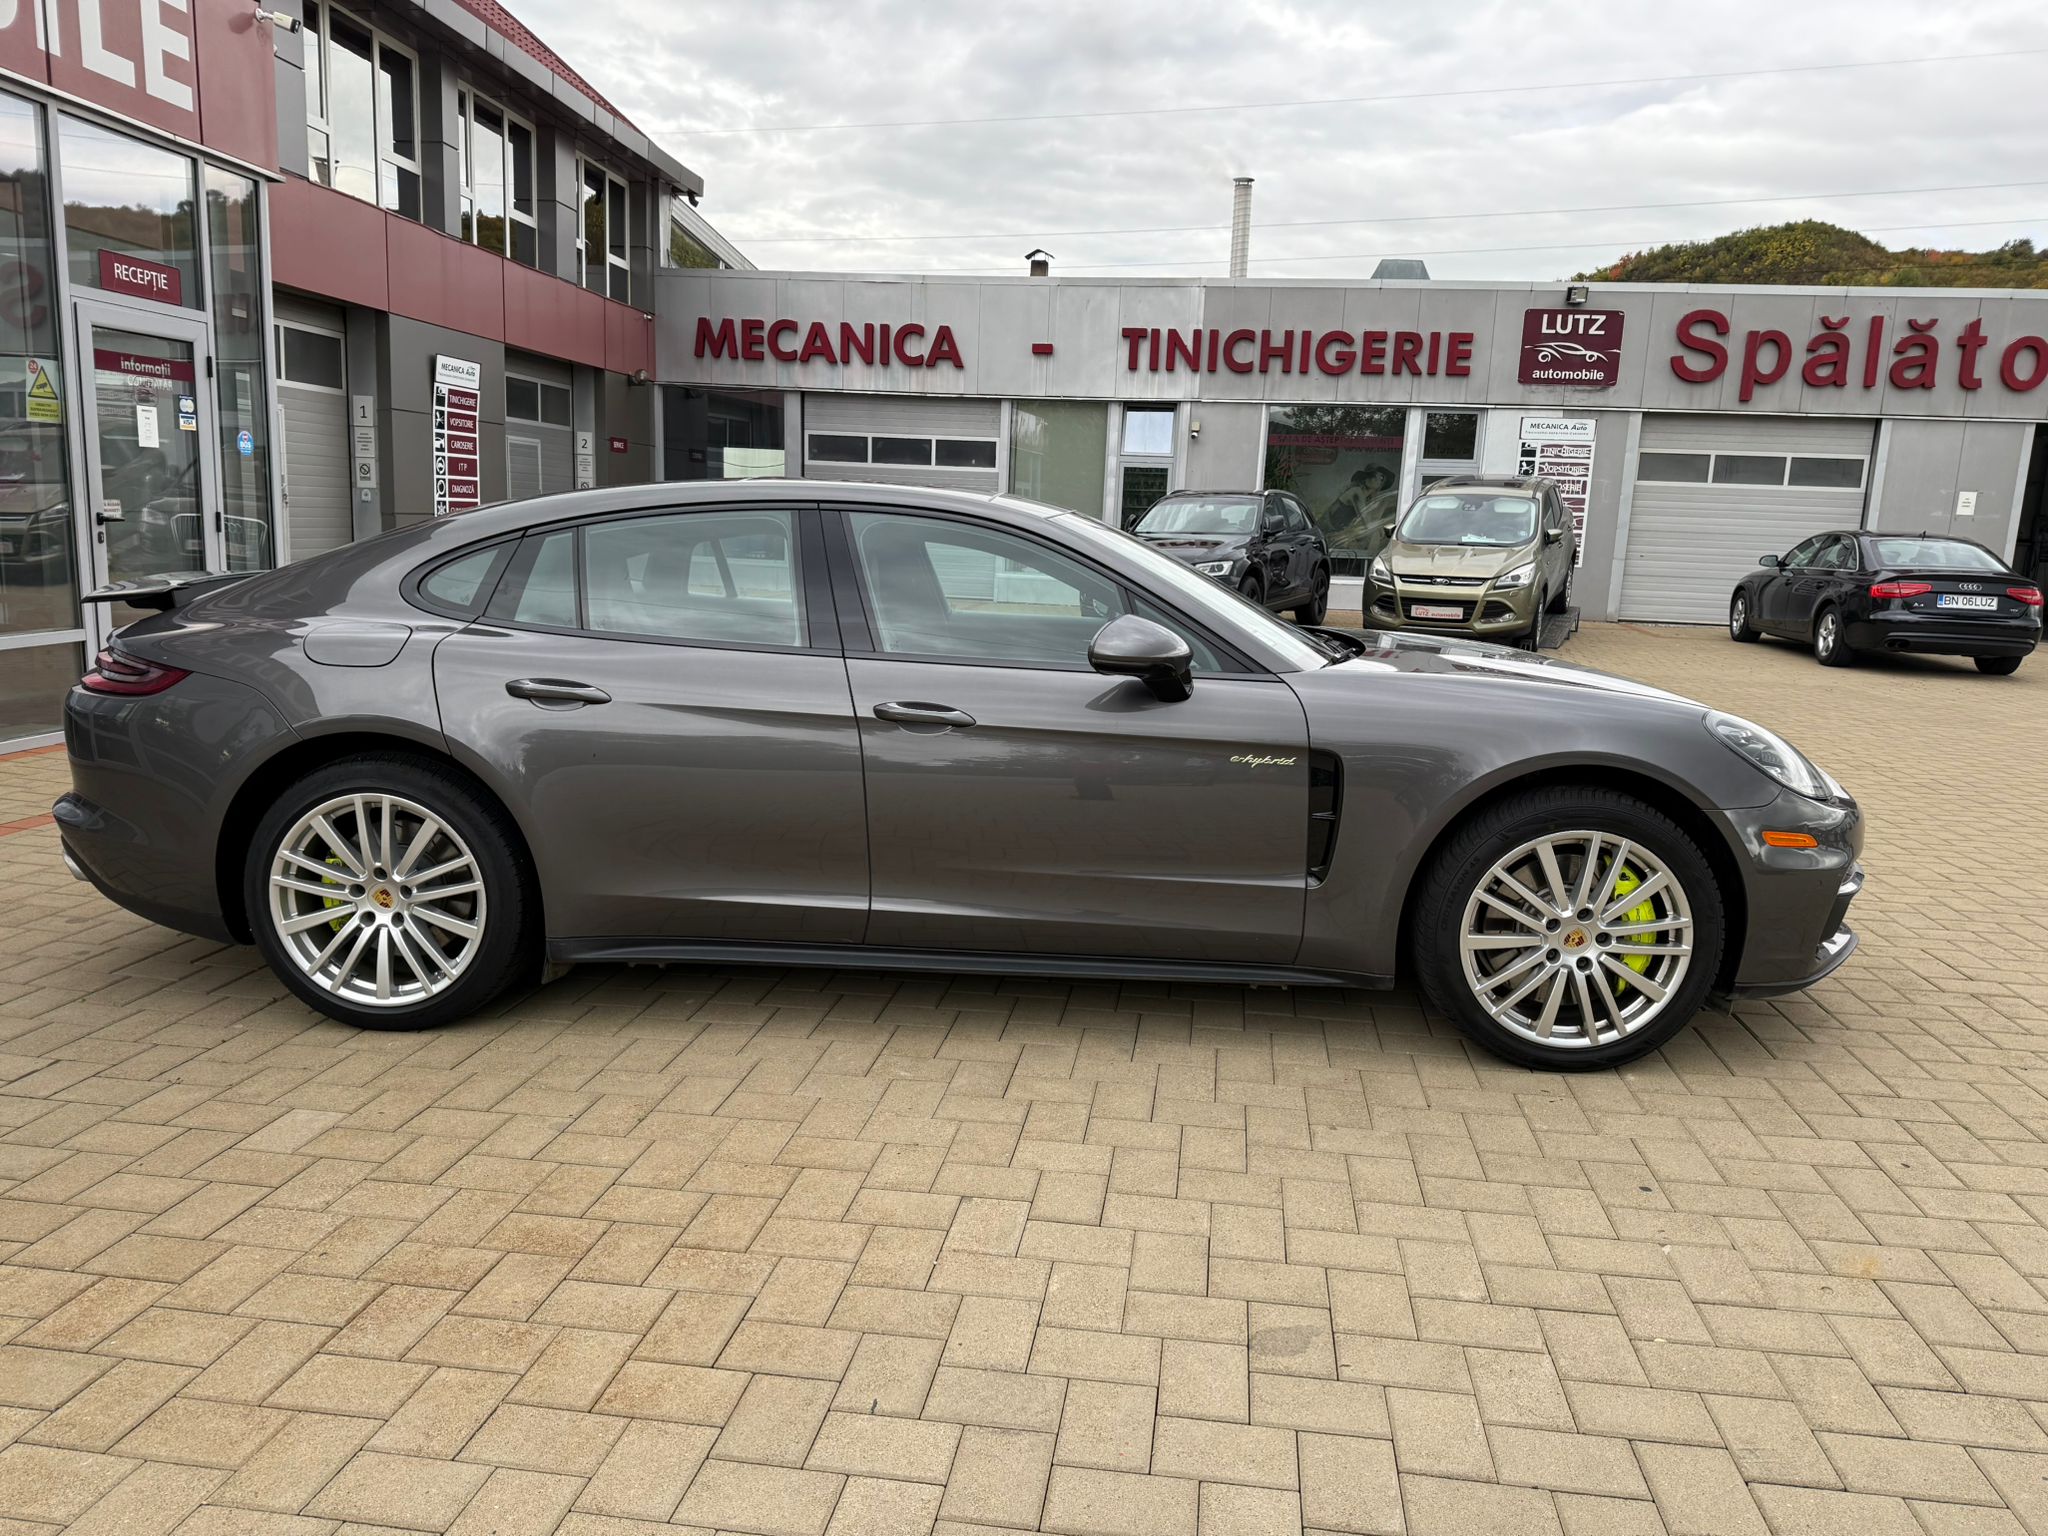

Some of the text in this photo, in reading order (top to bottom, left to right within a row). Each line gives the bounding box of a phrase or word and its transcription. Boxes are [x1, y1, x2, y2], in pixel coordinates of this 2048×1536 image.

[0, 0, 193, 112] ILE
[1541, 313, 1607, 335] LUTZ
[694, 317, 964, 369] MECANICA
[1122, 328, 1474, 377] TINICHIGERIE
[441, 362, 465, 374] MECANICA
[1532, 368, 1604, 381] automobile
[449, 394, 476, 407] TINICHIGERIE
[360, 405, 367, 419] 1
[449, 417, 474, 429] VOPSITORIE
[450, 440, 474, 451] CAROSERIE
[581, 438, 588, 449] 2
[1544, 447, 1590, 456] TINICHIGERIE
[1543, 464, 1586, 474] VOPSITORIE
[1944, 595, 1994, 607] BN 06LUZ
[1415, 609, 1429, 617] LUTZ
[1230, 754, 1297, 768] e-hybrid
